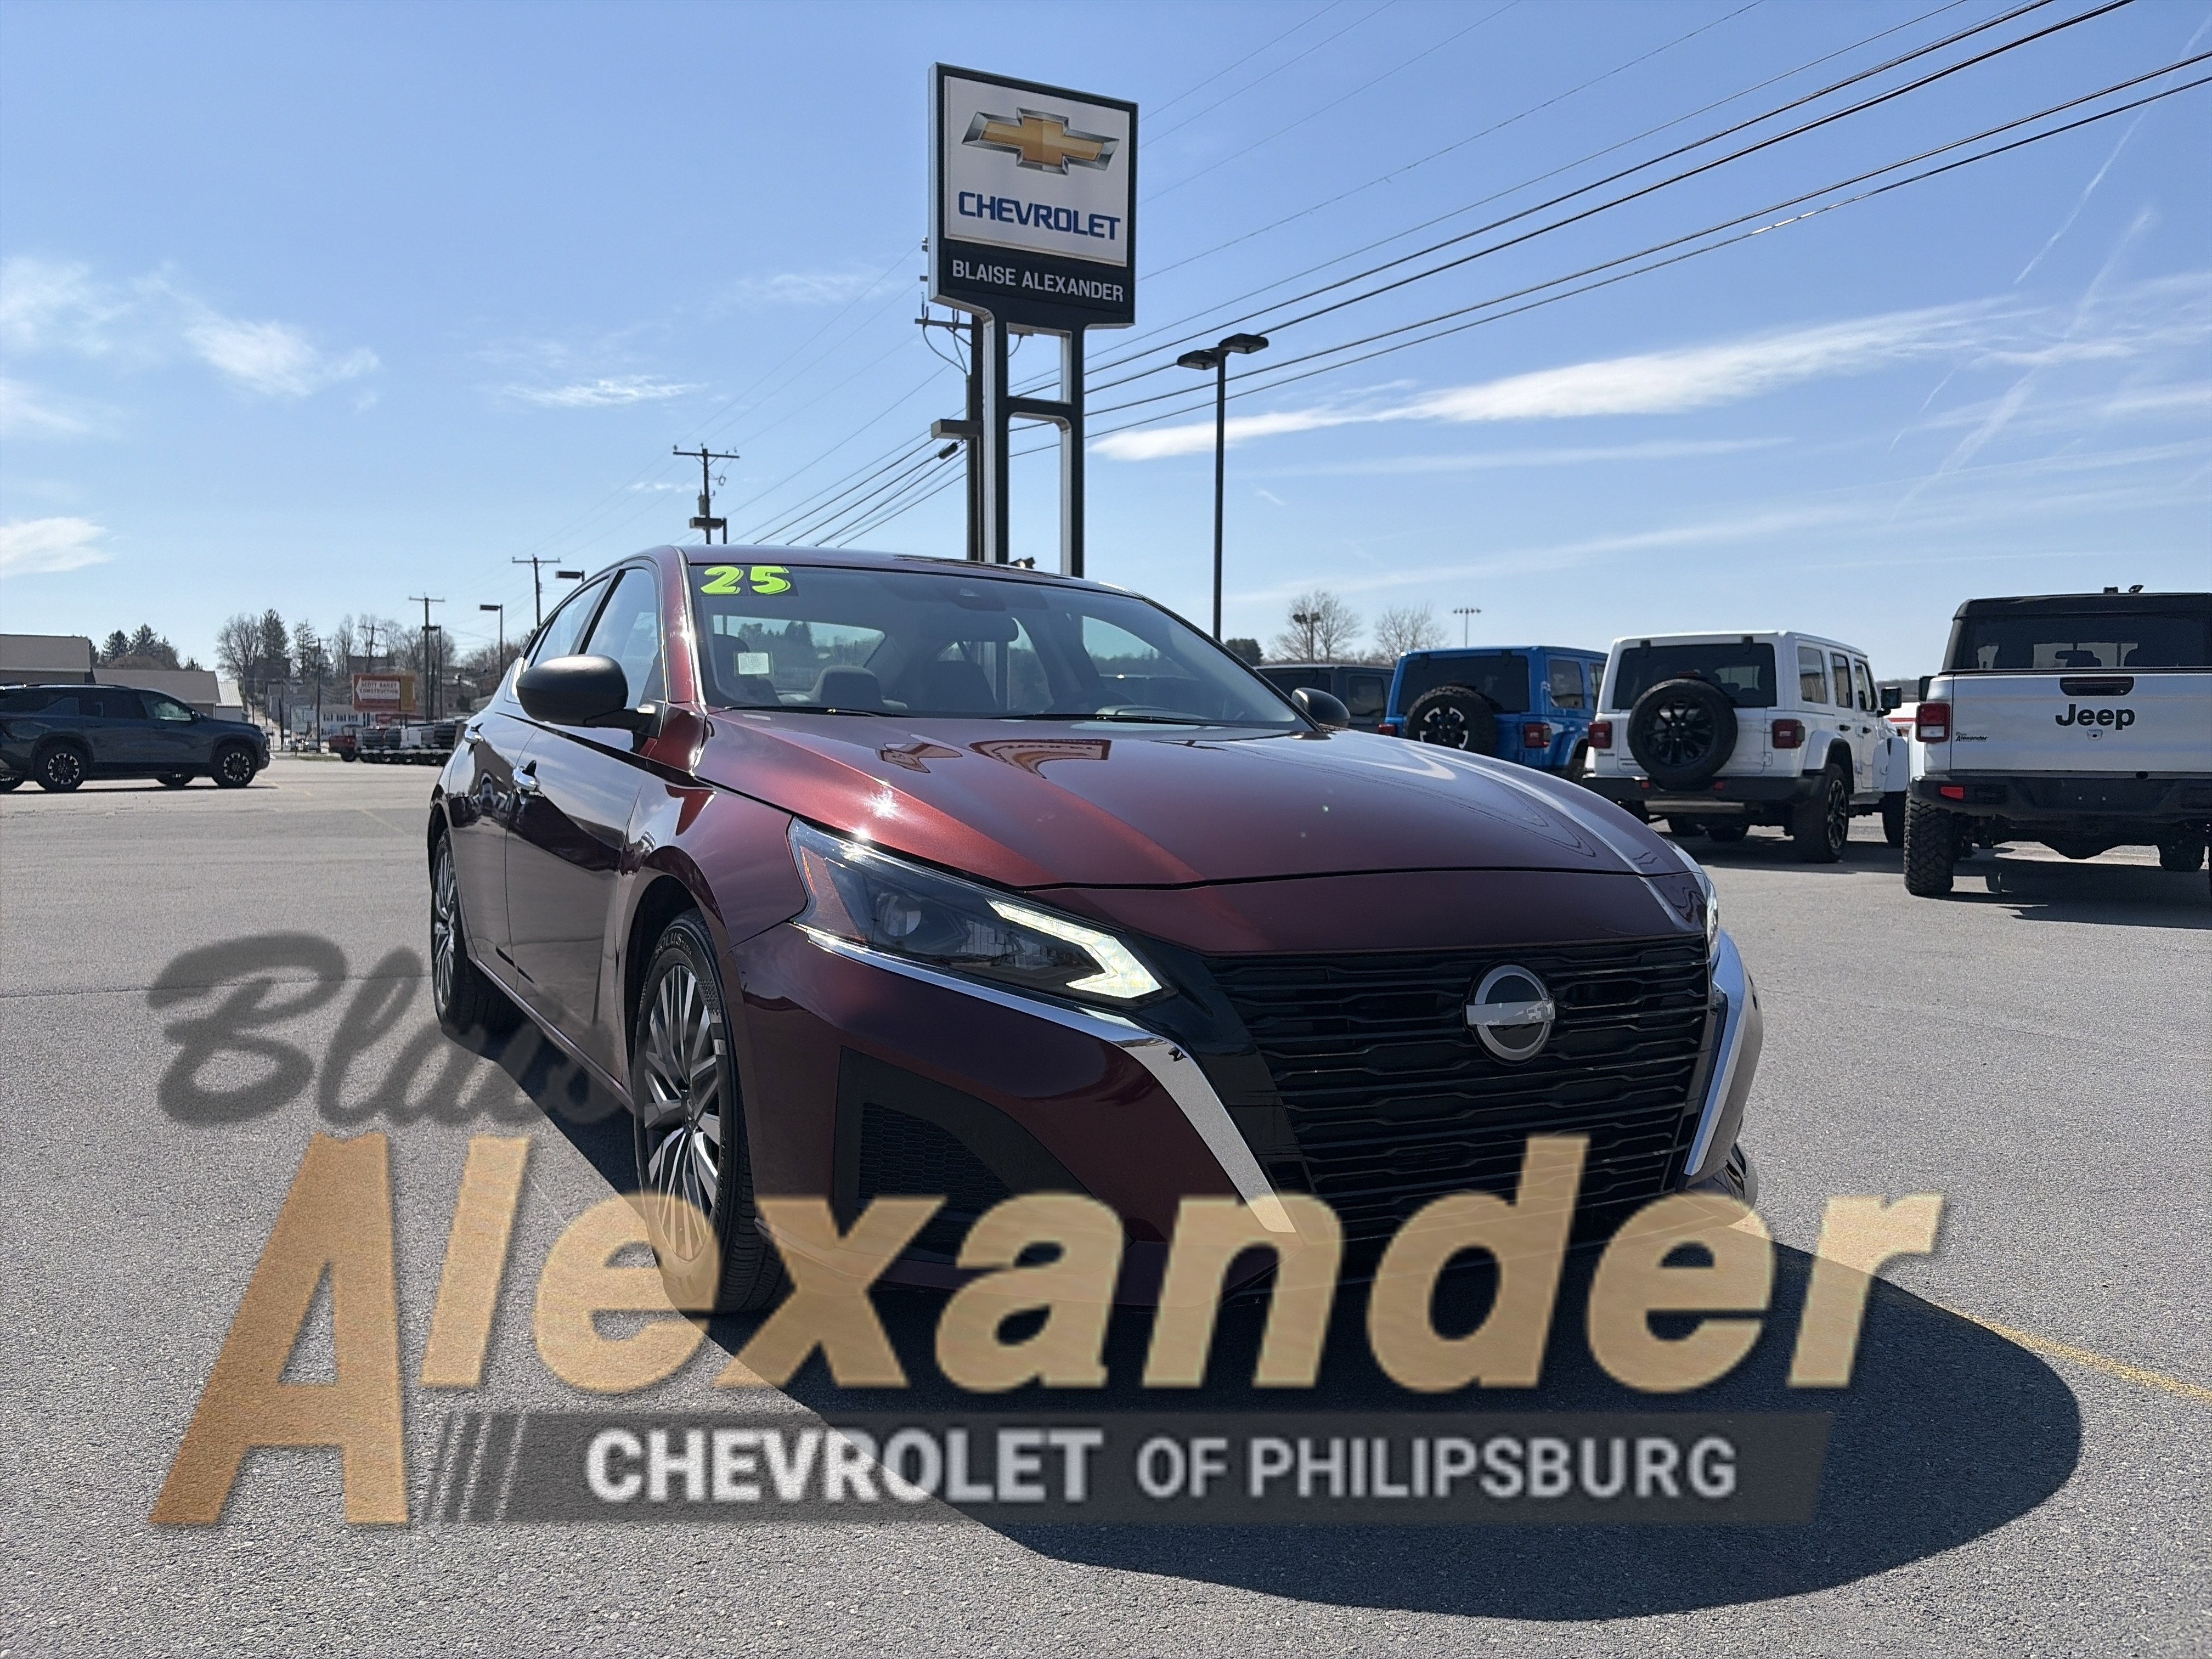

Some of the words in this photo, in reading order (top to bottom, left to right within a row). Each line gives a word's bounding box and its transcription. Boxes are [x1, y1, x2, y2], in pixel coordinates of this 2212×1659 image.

[958, 191, 1121, 240] CHEVROLET
[952, 259, 1016, 286] BLAISE
[1022, 271, 1124, 302] ALEXANDER
[700, 566, 791, 595] 25
[2055, 704, 2135, 730] Jeep
